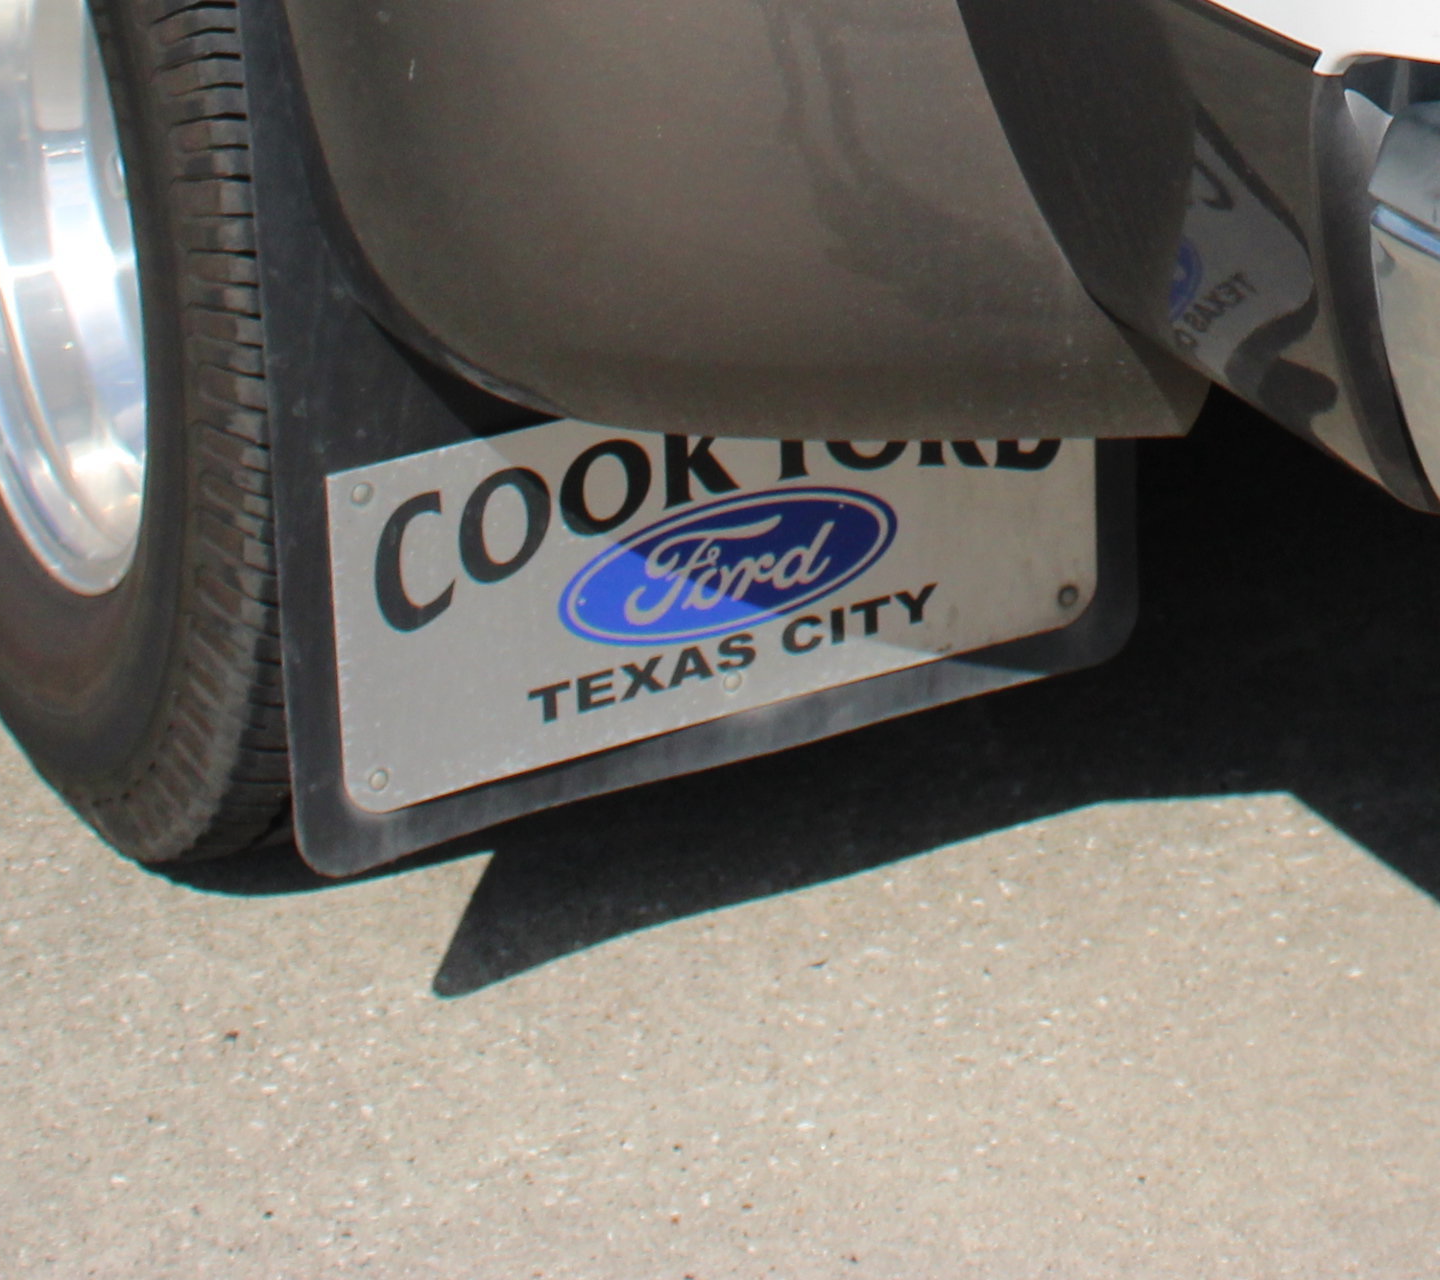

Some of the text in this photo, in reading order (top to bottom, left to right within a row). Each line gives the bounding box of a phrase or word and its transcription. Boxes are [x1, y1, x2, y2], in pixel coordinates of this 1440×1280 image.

[374, 433, 741, 634] COOK
[624, 514, 836, 625] Ford
[527, 582, 939, 724] TEXAS CITY
